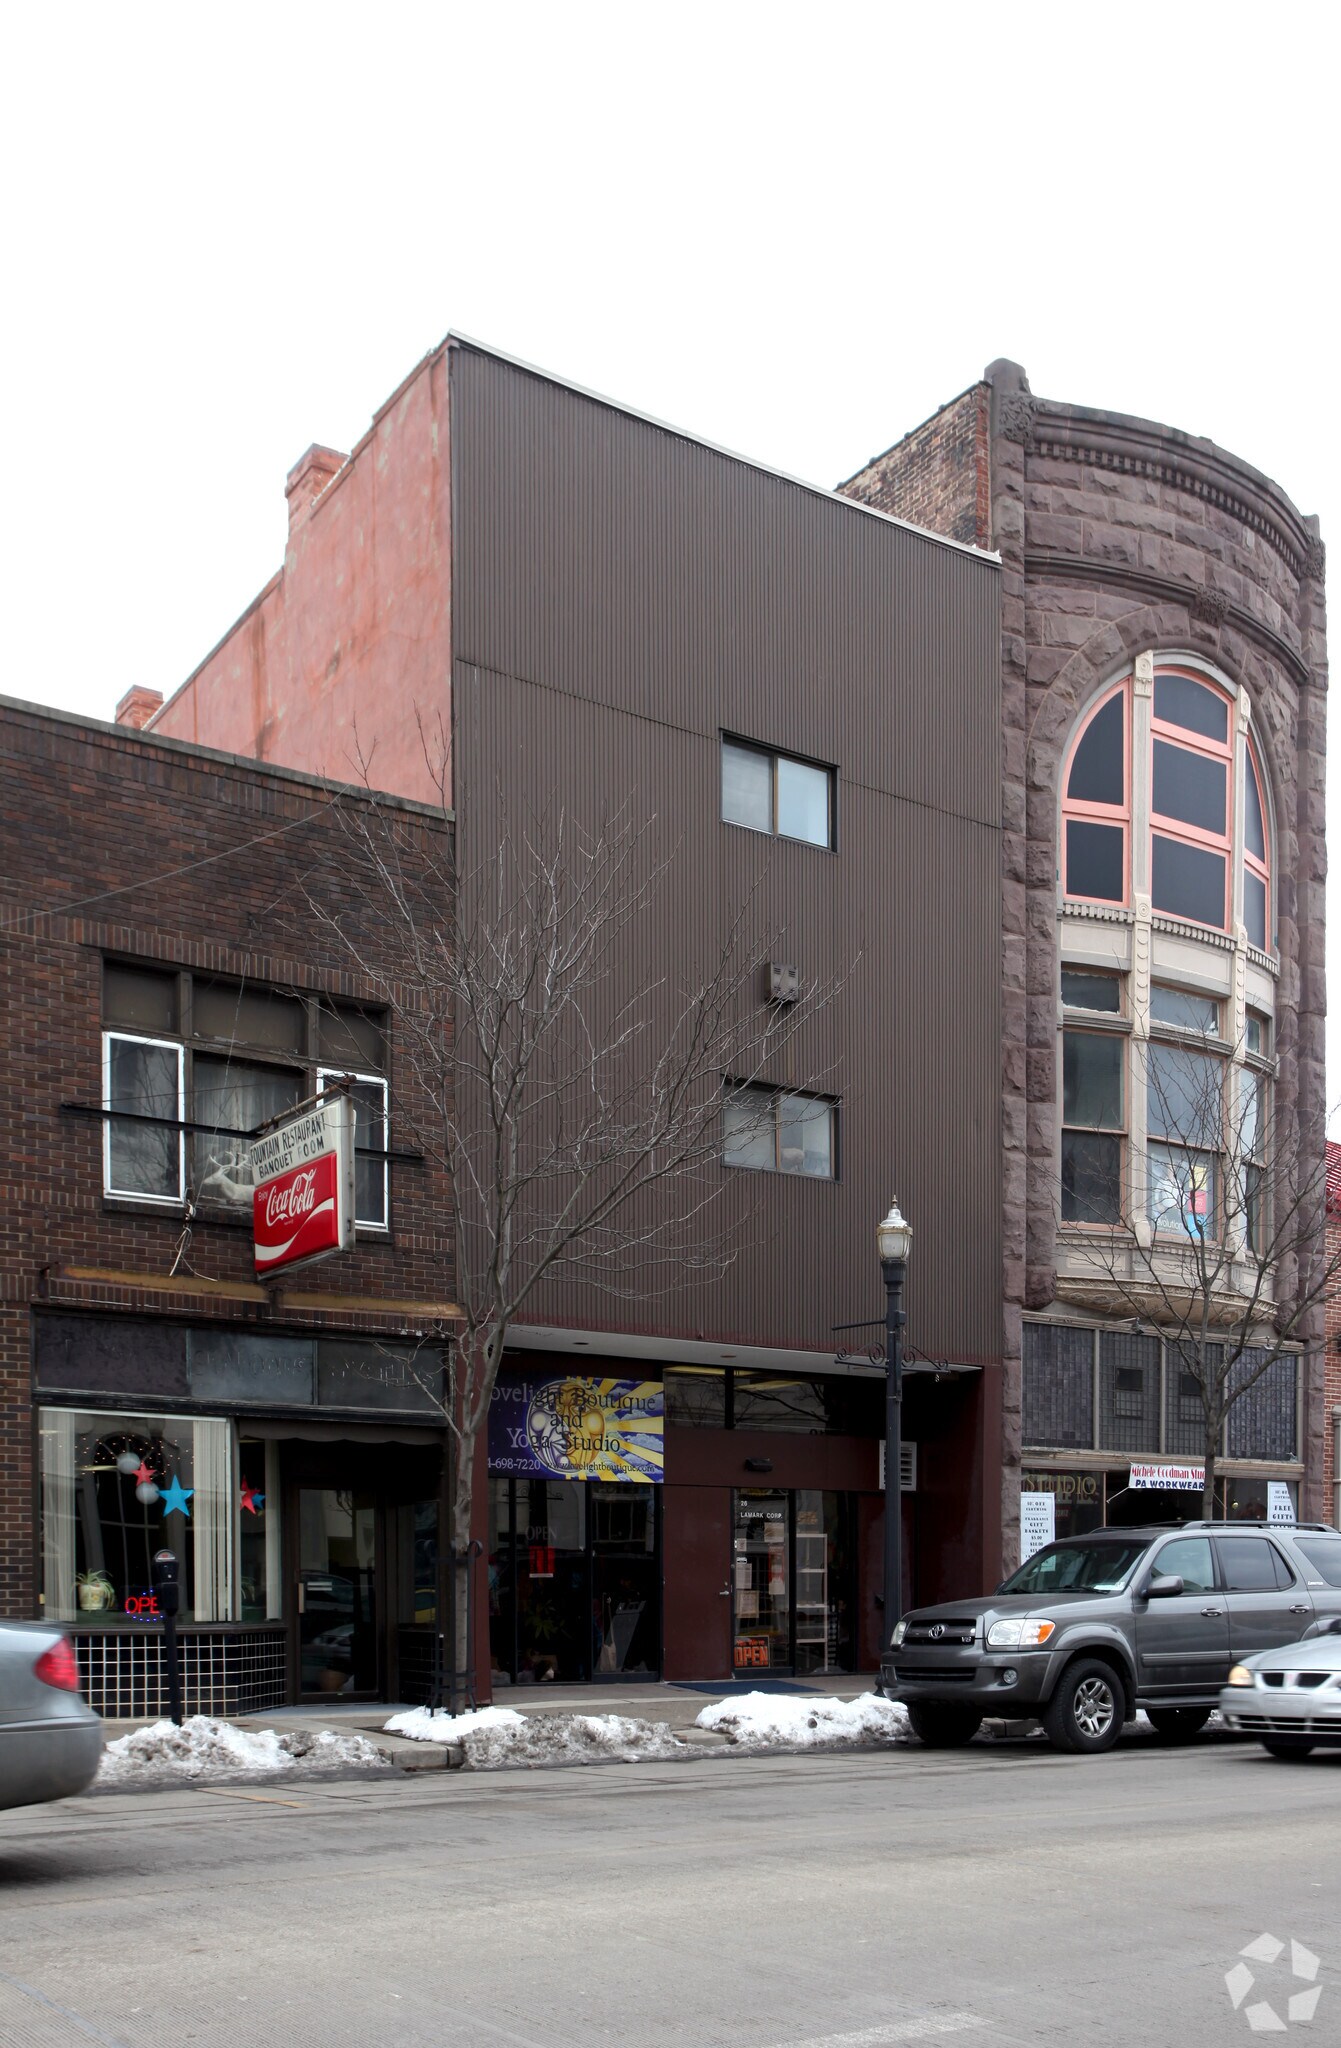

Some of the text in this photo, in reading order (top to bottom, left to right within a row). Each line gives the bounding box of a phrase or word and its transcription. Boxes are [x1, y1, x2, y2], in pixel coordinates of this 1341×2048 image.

[250, 1136, 280, 1167] FOUNTAIN
[258, 1150, 293, 1179] BANQUET
[266, 1168, 317, 1227] Coca-Cola
[491, 1383, 657, 1414] ovelight Boutique
[550, 1410, 584, 1429] and
[506, 1427, 621, 1454] Yoga Studio
[1132, 1465, 1156, 1478] Michele
[1157, 1466, 1190, 1479] Goodman
[1026, 1474, 1098, 1495] STUDIO
[1135, 1479, 1206, 1490] PA WORKWEAR
[524, 1525, 560, 1541] OPEN
[124, 1595, 161, 1615] OPE
[733, 1646, 769, 1667] OPEN
